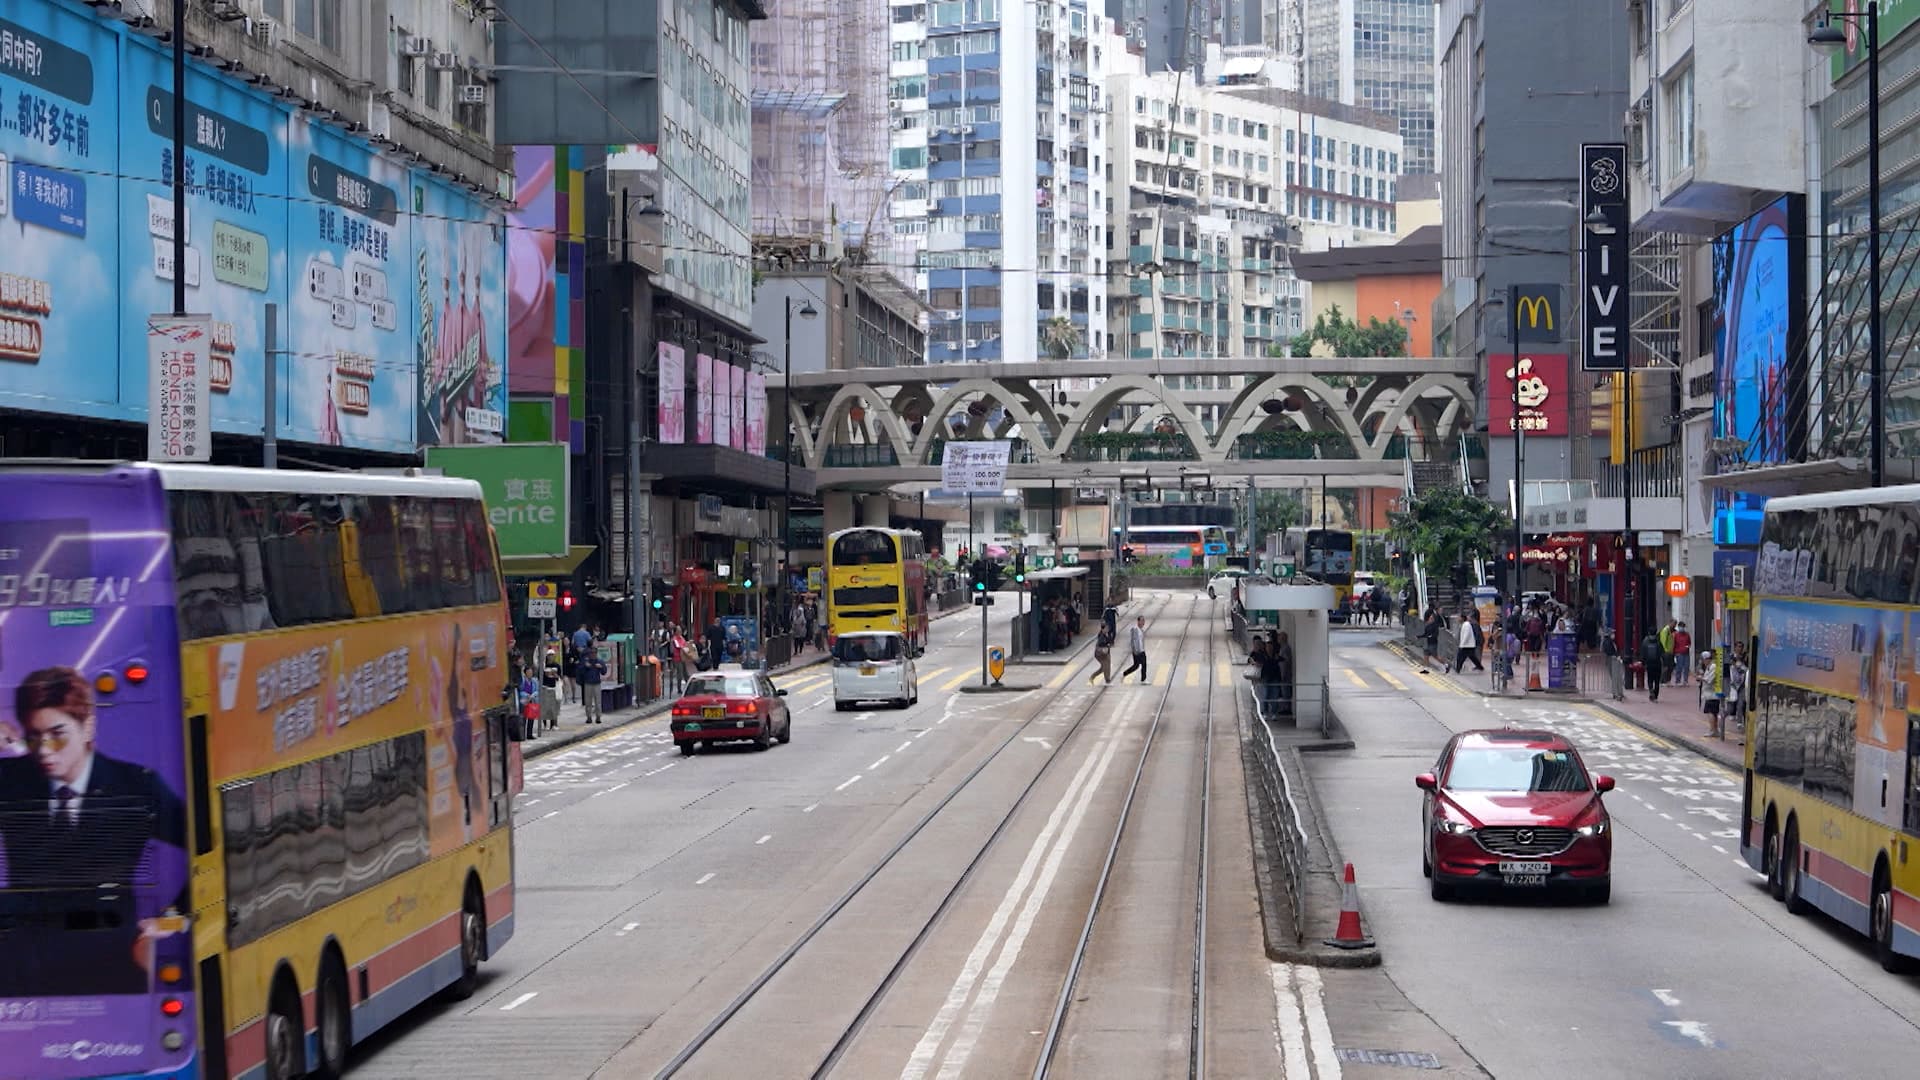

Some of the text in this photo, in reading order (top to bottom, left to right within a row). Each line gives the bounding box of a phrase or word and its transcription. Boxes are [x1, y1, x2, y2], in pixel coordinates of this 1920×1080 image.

[0, 29, 43, 76] 同中同?
[169, 351, 182, 456] HONG KONG
[504, 478, 553, 502] 實惠
